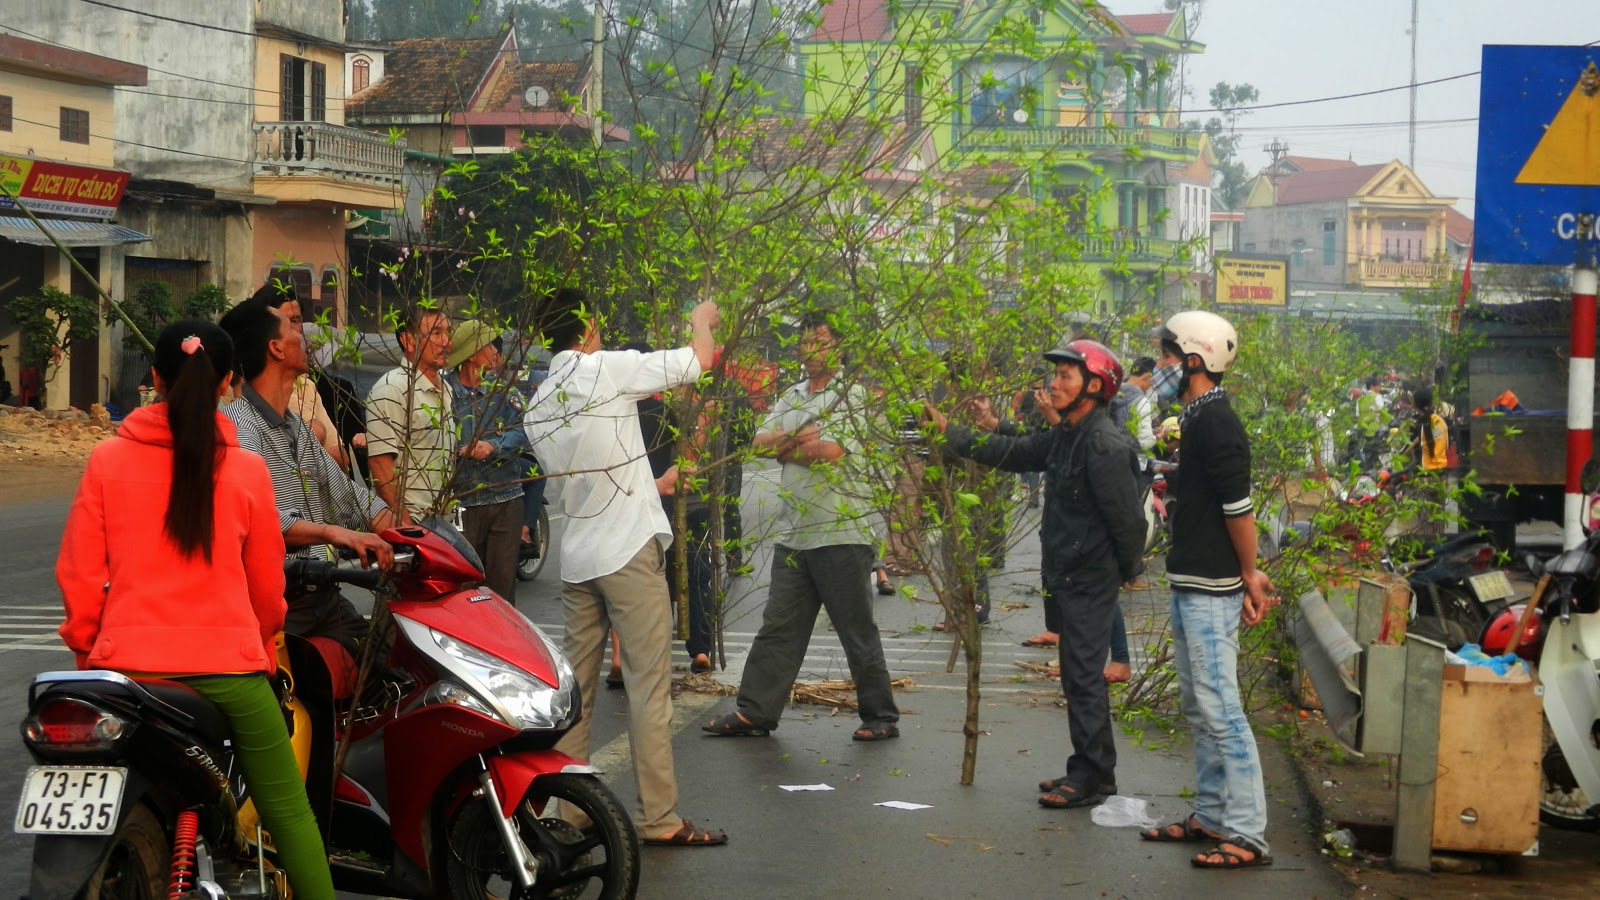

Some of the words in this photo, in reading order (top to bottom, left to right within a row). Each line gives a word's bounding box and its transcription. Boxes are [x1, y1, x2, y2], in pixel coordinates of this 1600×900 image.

[32, 173, 62, 197] DỊCH
[63, 177, 80, 201] VỤ
[441, 720, 485, 738] HONDA
[41, 771, 109, 799] 73-F1
[23, 802, 113, 831] 045.35
